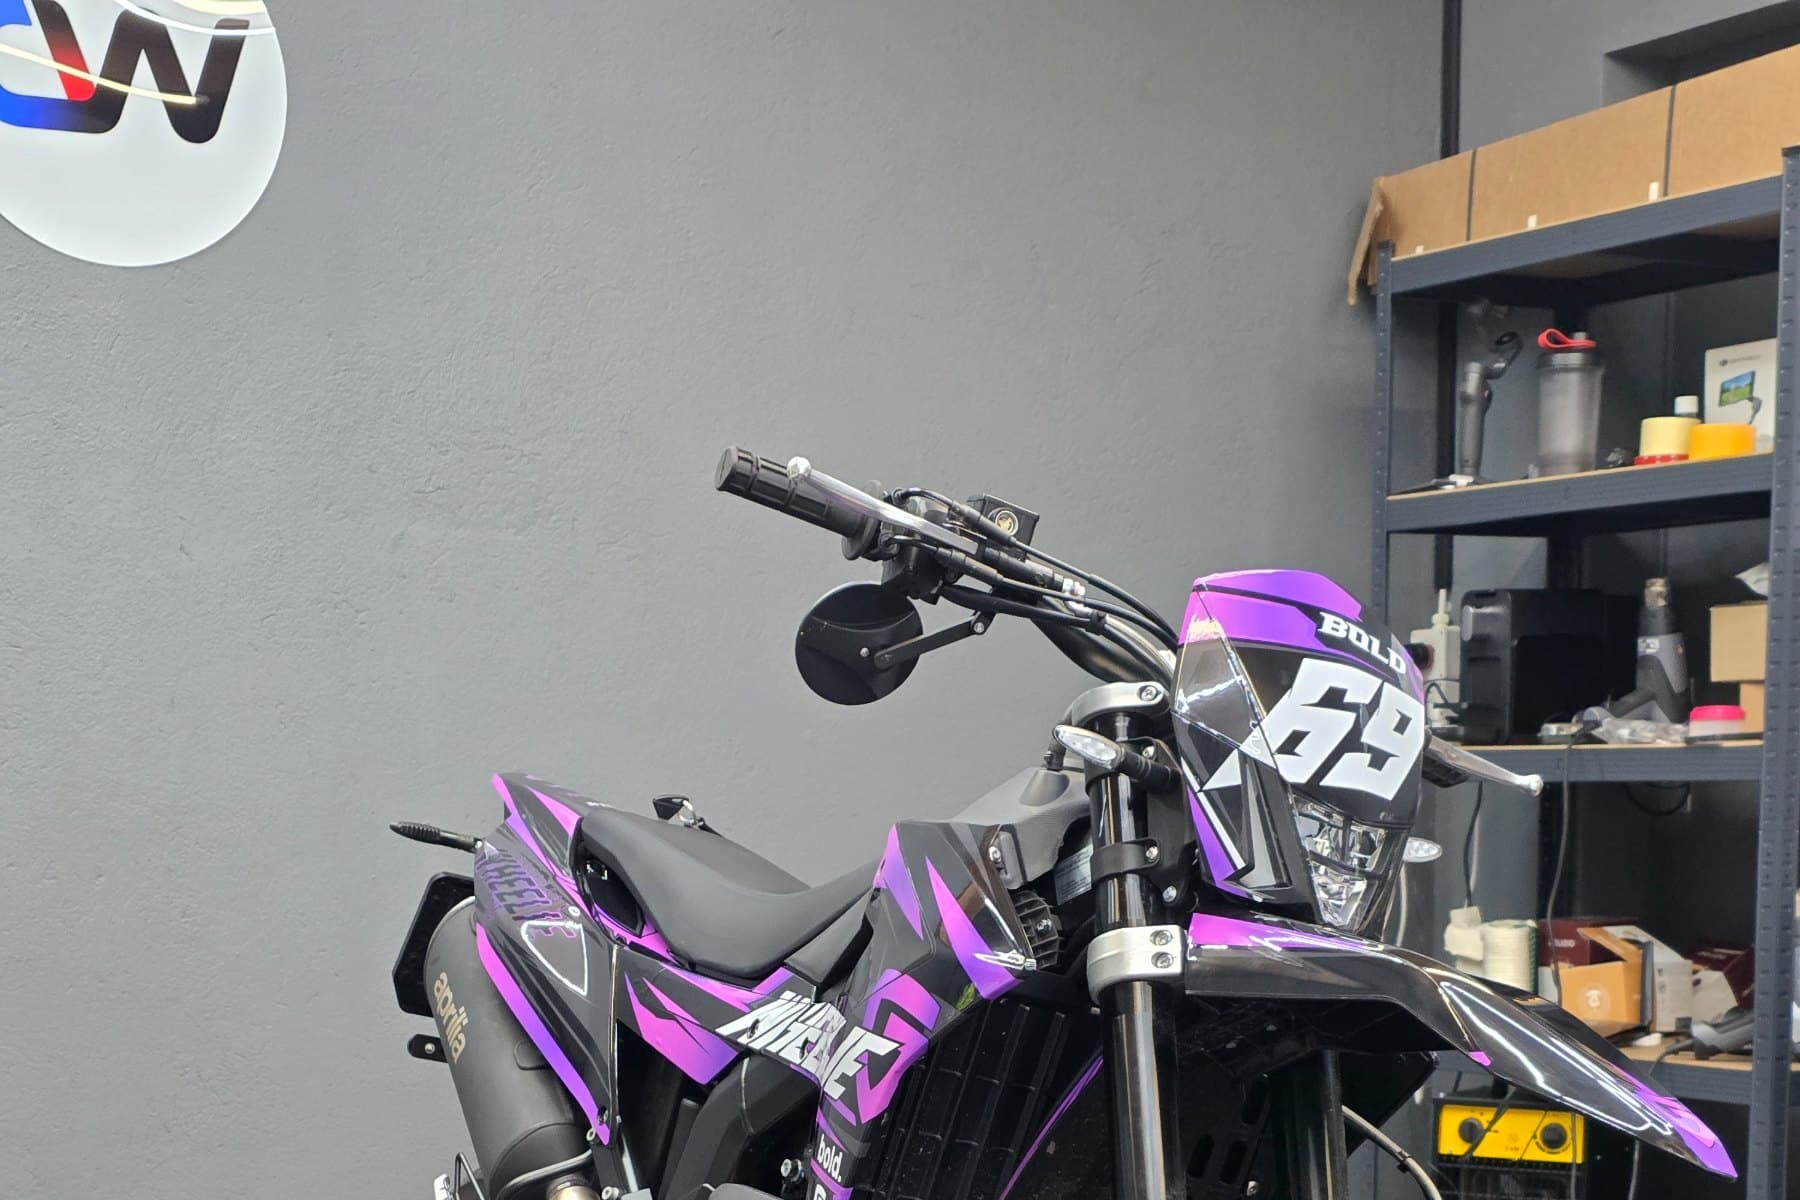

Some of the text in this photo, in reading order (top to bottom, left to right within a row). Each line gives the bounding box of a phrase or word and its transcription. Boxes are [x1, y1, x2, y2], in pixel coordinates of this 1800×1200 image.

[1316, 610, 1407, 674] BOLD
[1241, 656, 1425, 801] 69
[433, 971, 469, 1065] aprilia
[817, 1132, 844, 1183] bold.
